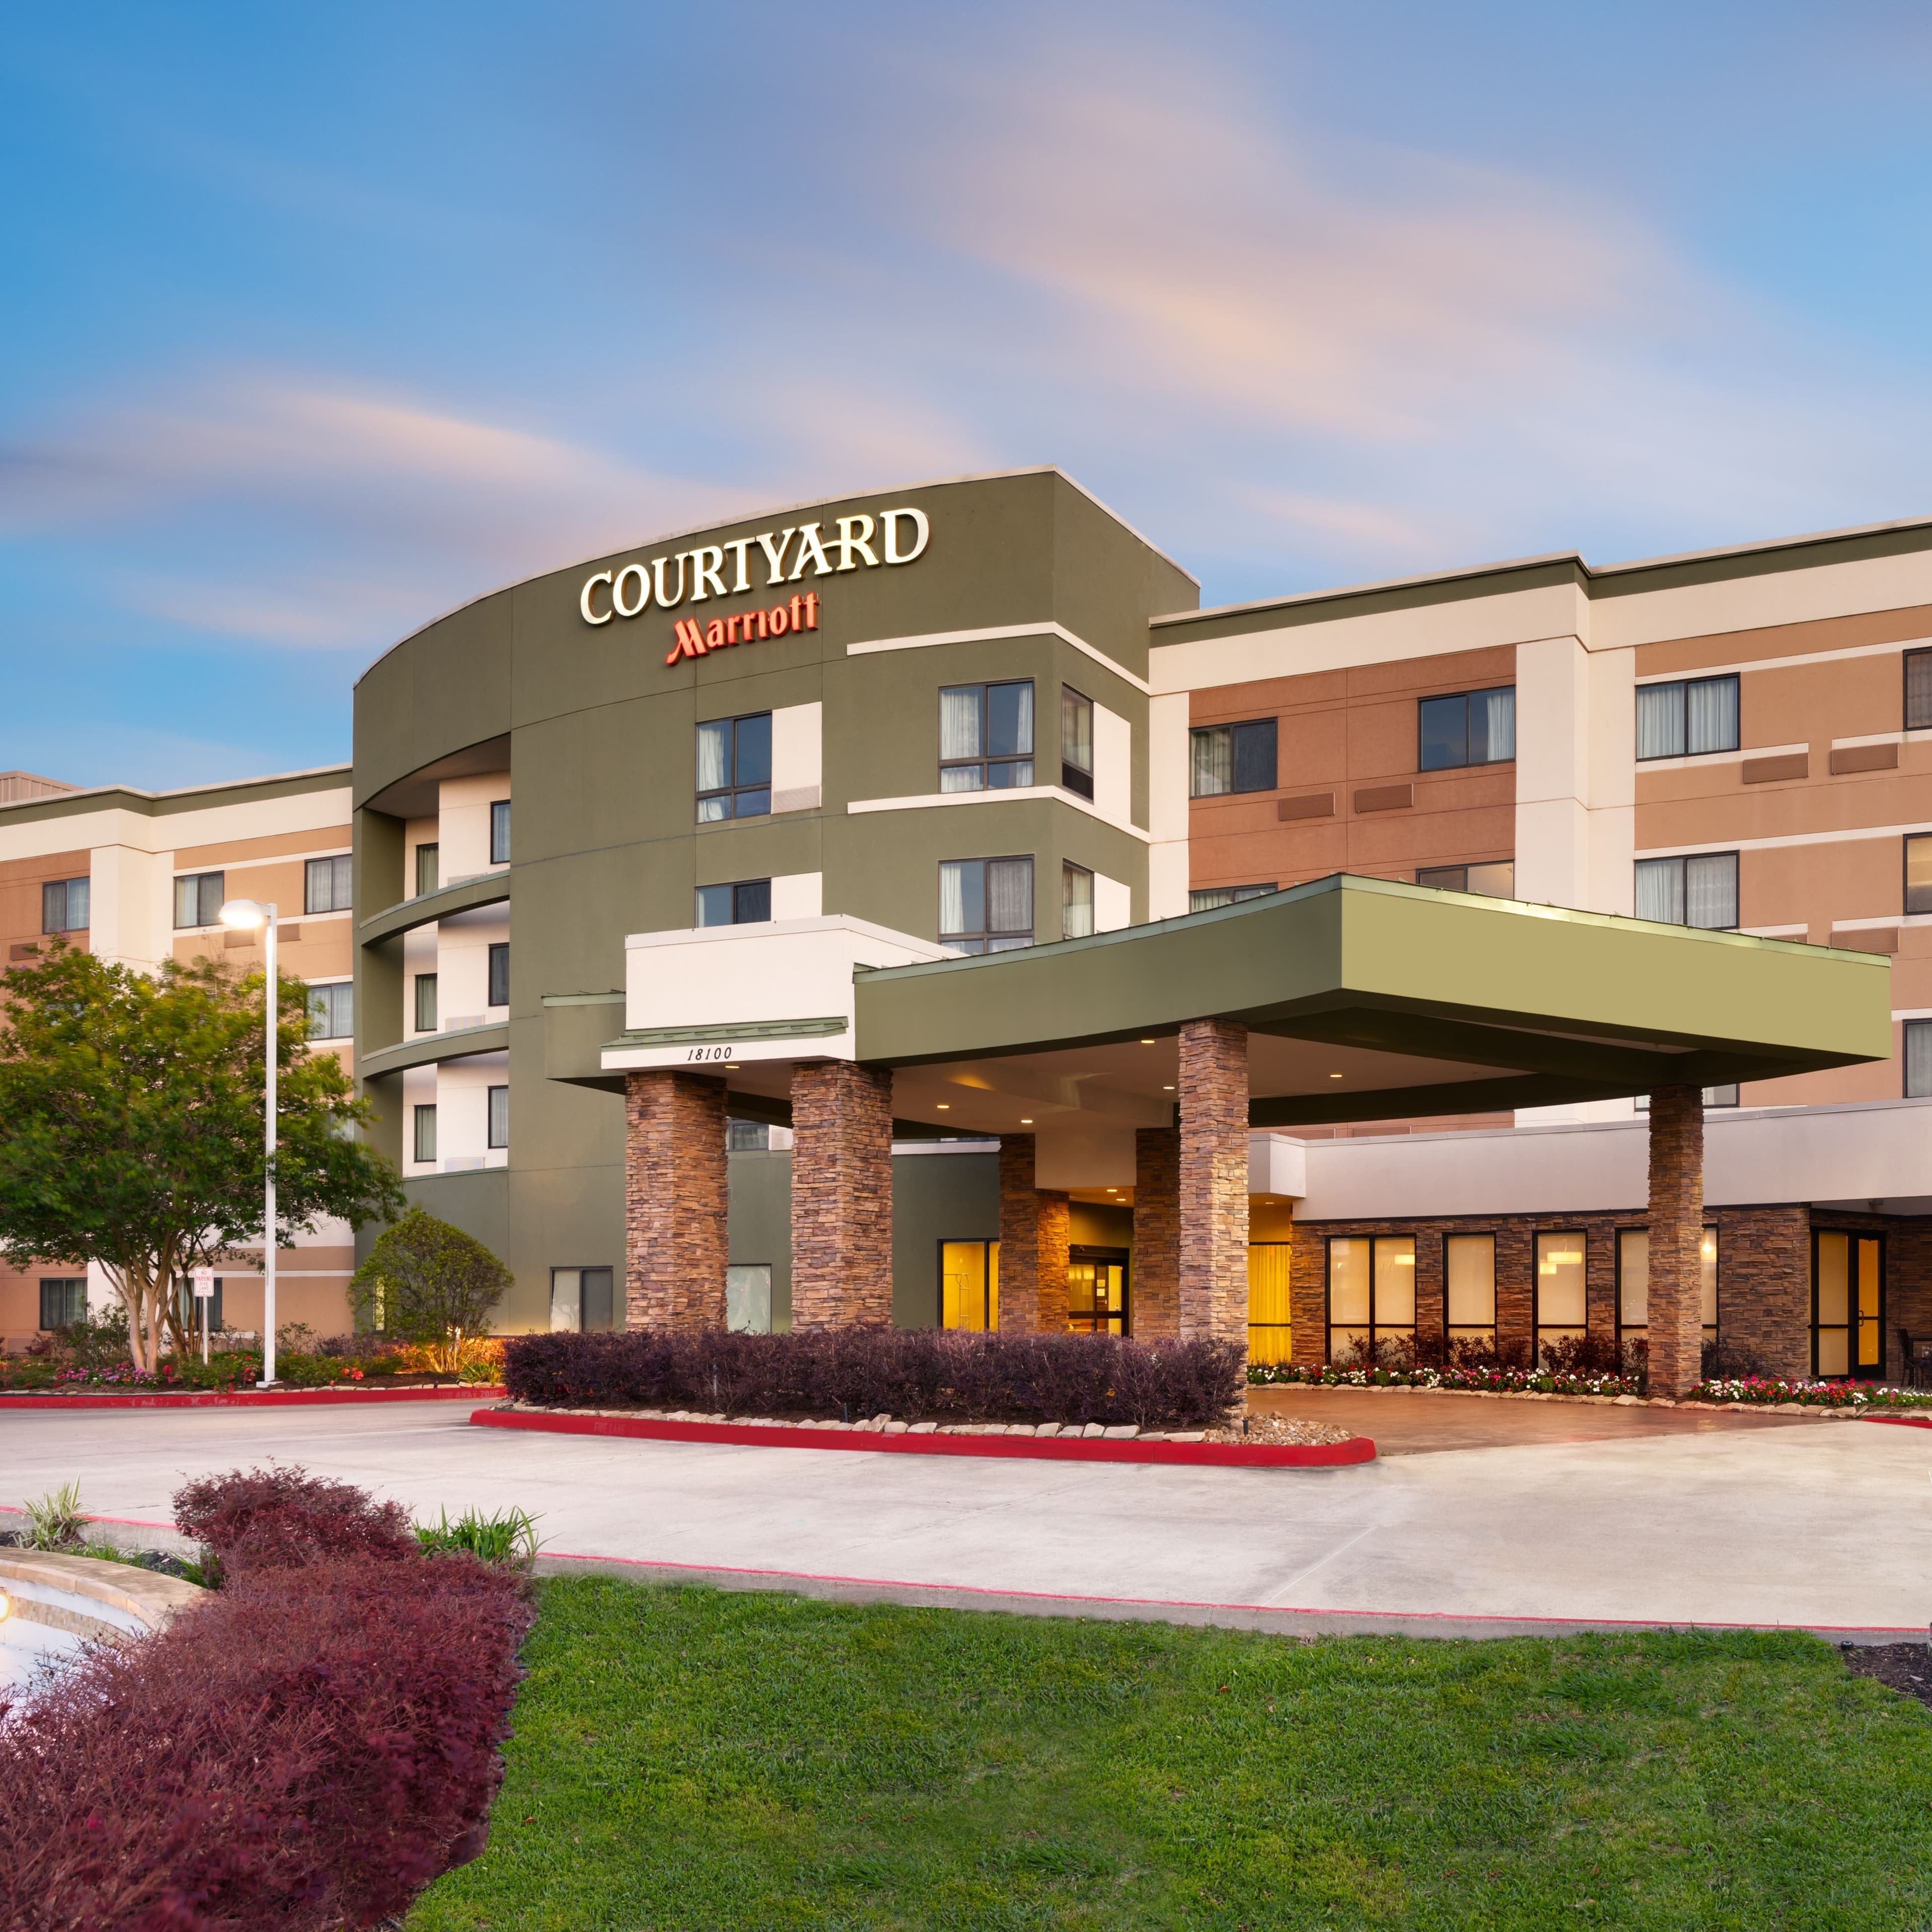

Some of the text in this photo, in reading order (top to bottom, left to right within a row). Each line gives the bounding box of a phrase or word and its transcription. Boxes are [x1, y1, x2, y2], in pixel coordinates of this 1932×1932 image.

[580, 508, 931, 625] COURTYARD
[666, 592, 820, 666] Marriott
[687, 1047, 732, 1061] 18100
[594, 1422, 608, 1433] FIRE
[610, 1423, 626, 1434] LANE
